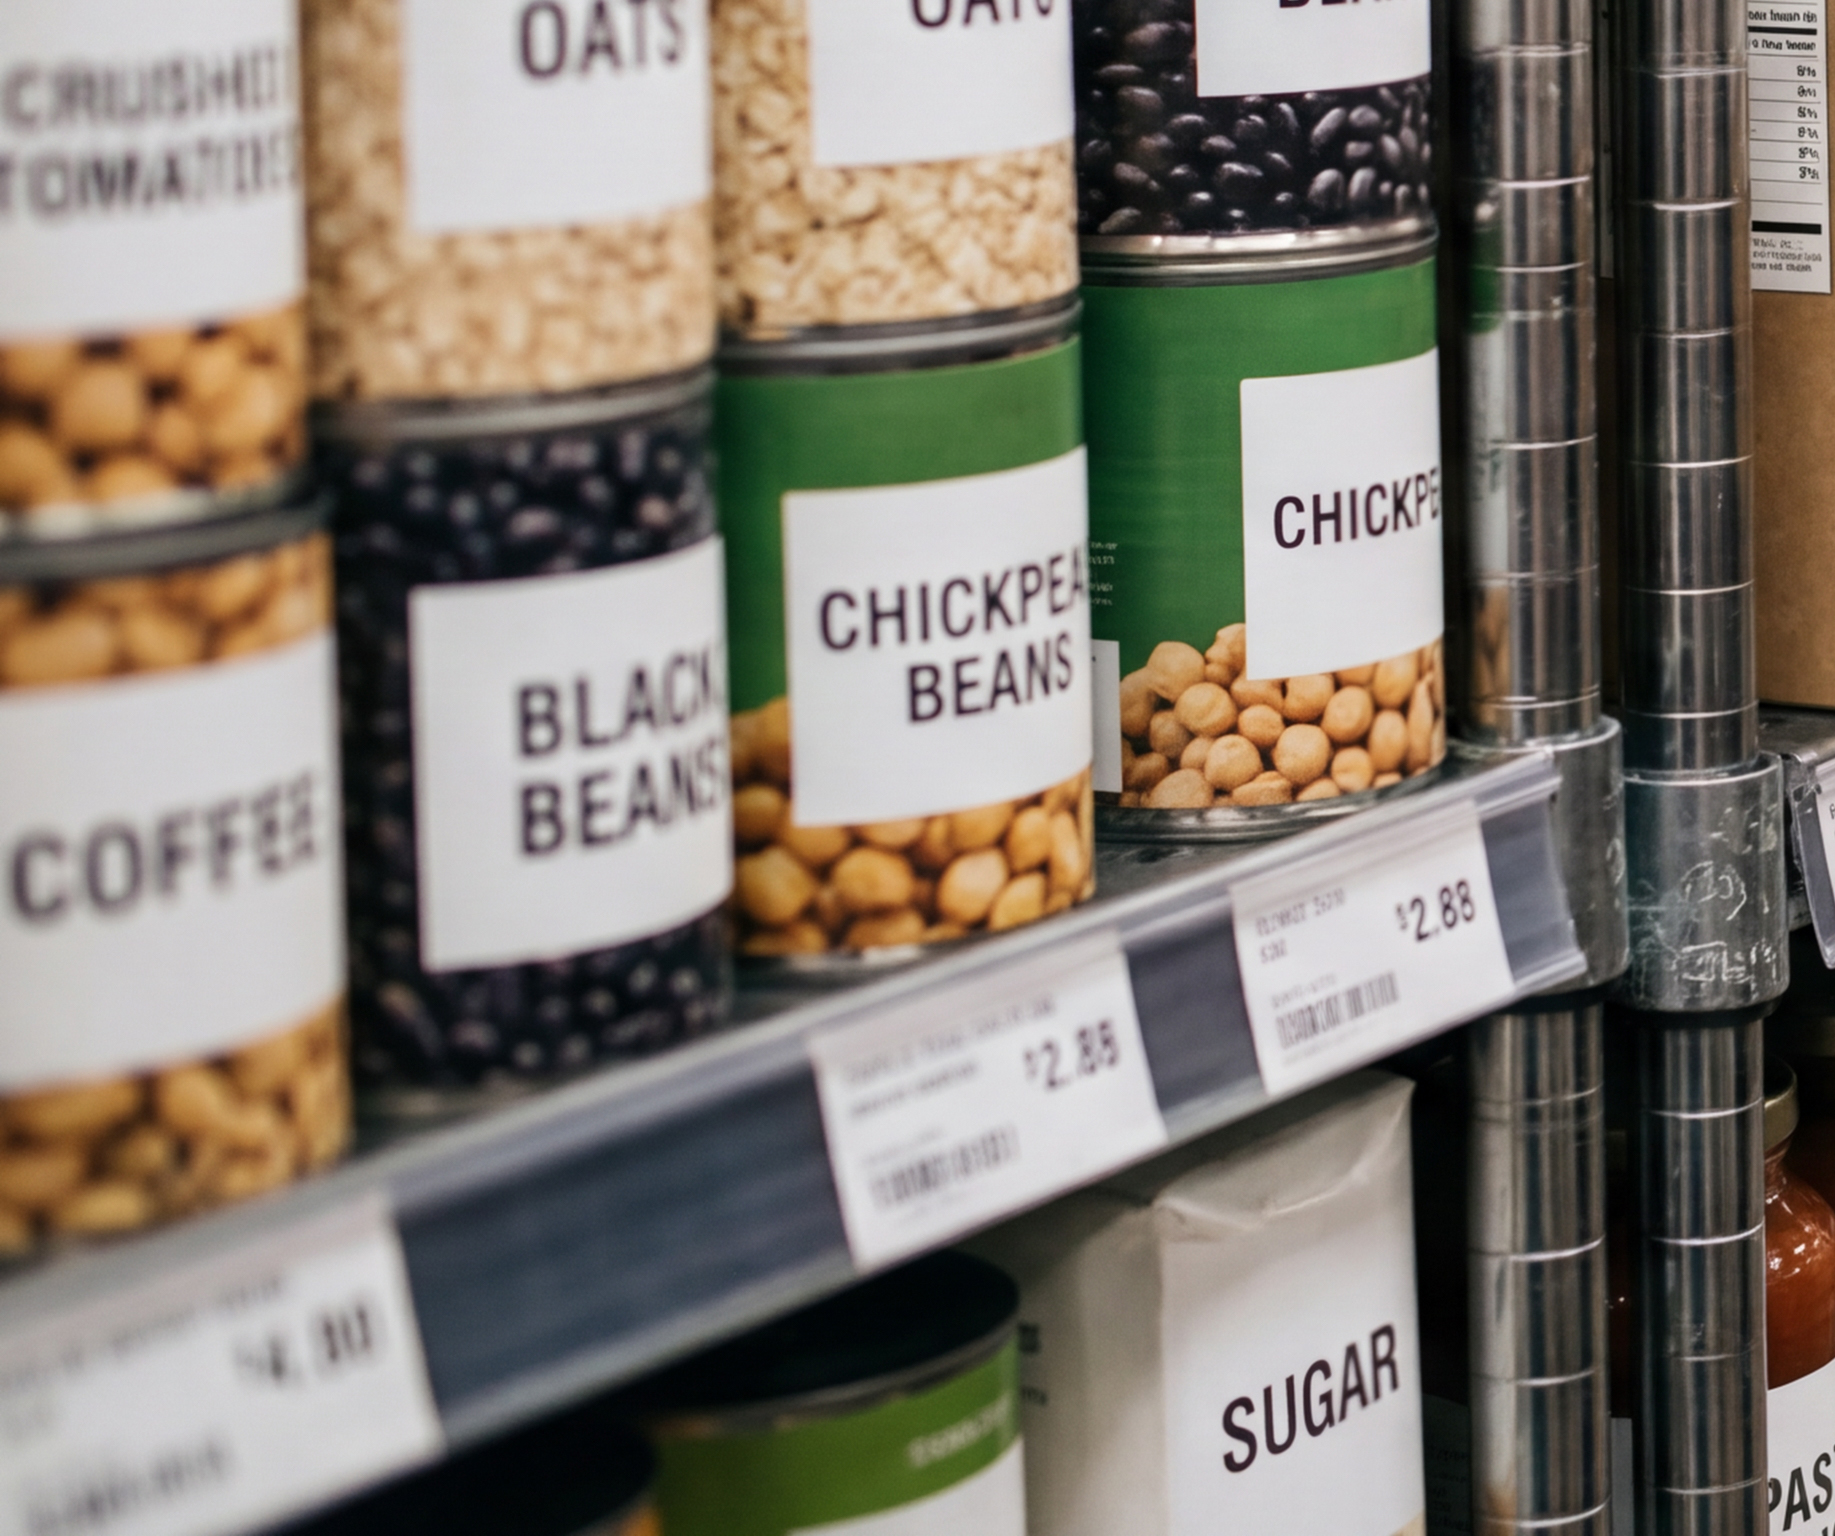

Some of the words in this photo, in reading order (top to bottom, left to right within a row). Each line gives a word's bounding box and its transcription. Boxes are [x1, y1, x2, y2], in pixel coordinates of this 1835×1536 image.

[906, 631, 1073, 724] BEANS
[11, 768, 314, 927] COFFEE
[520, 734, 722, 858] BEANS
[1396, 878, 1475, 942] $2.88
[1222, 1323, 1400, 1474] SUGAR
